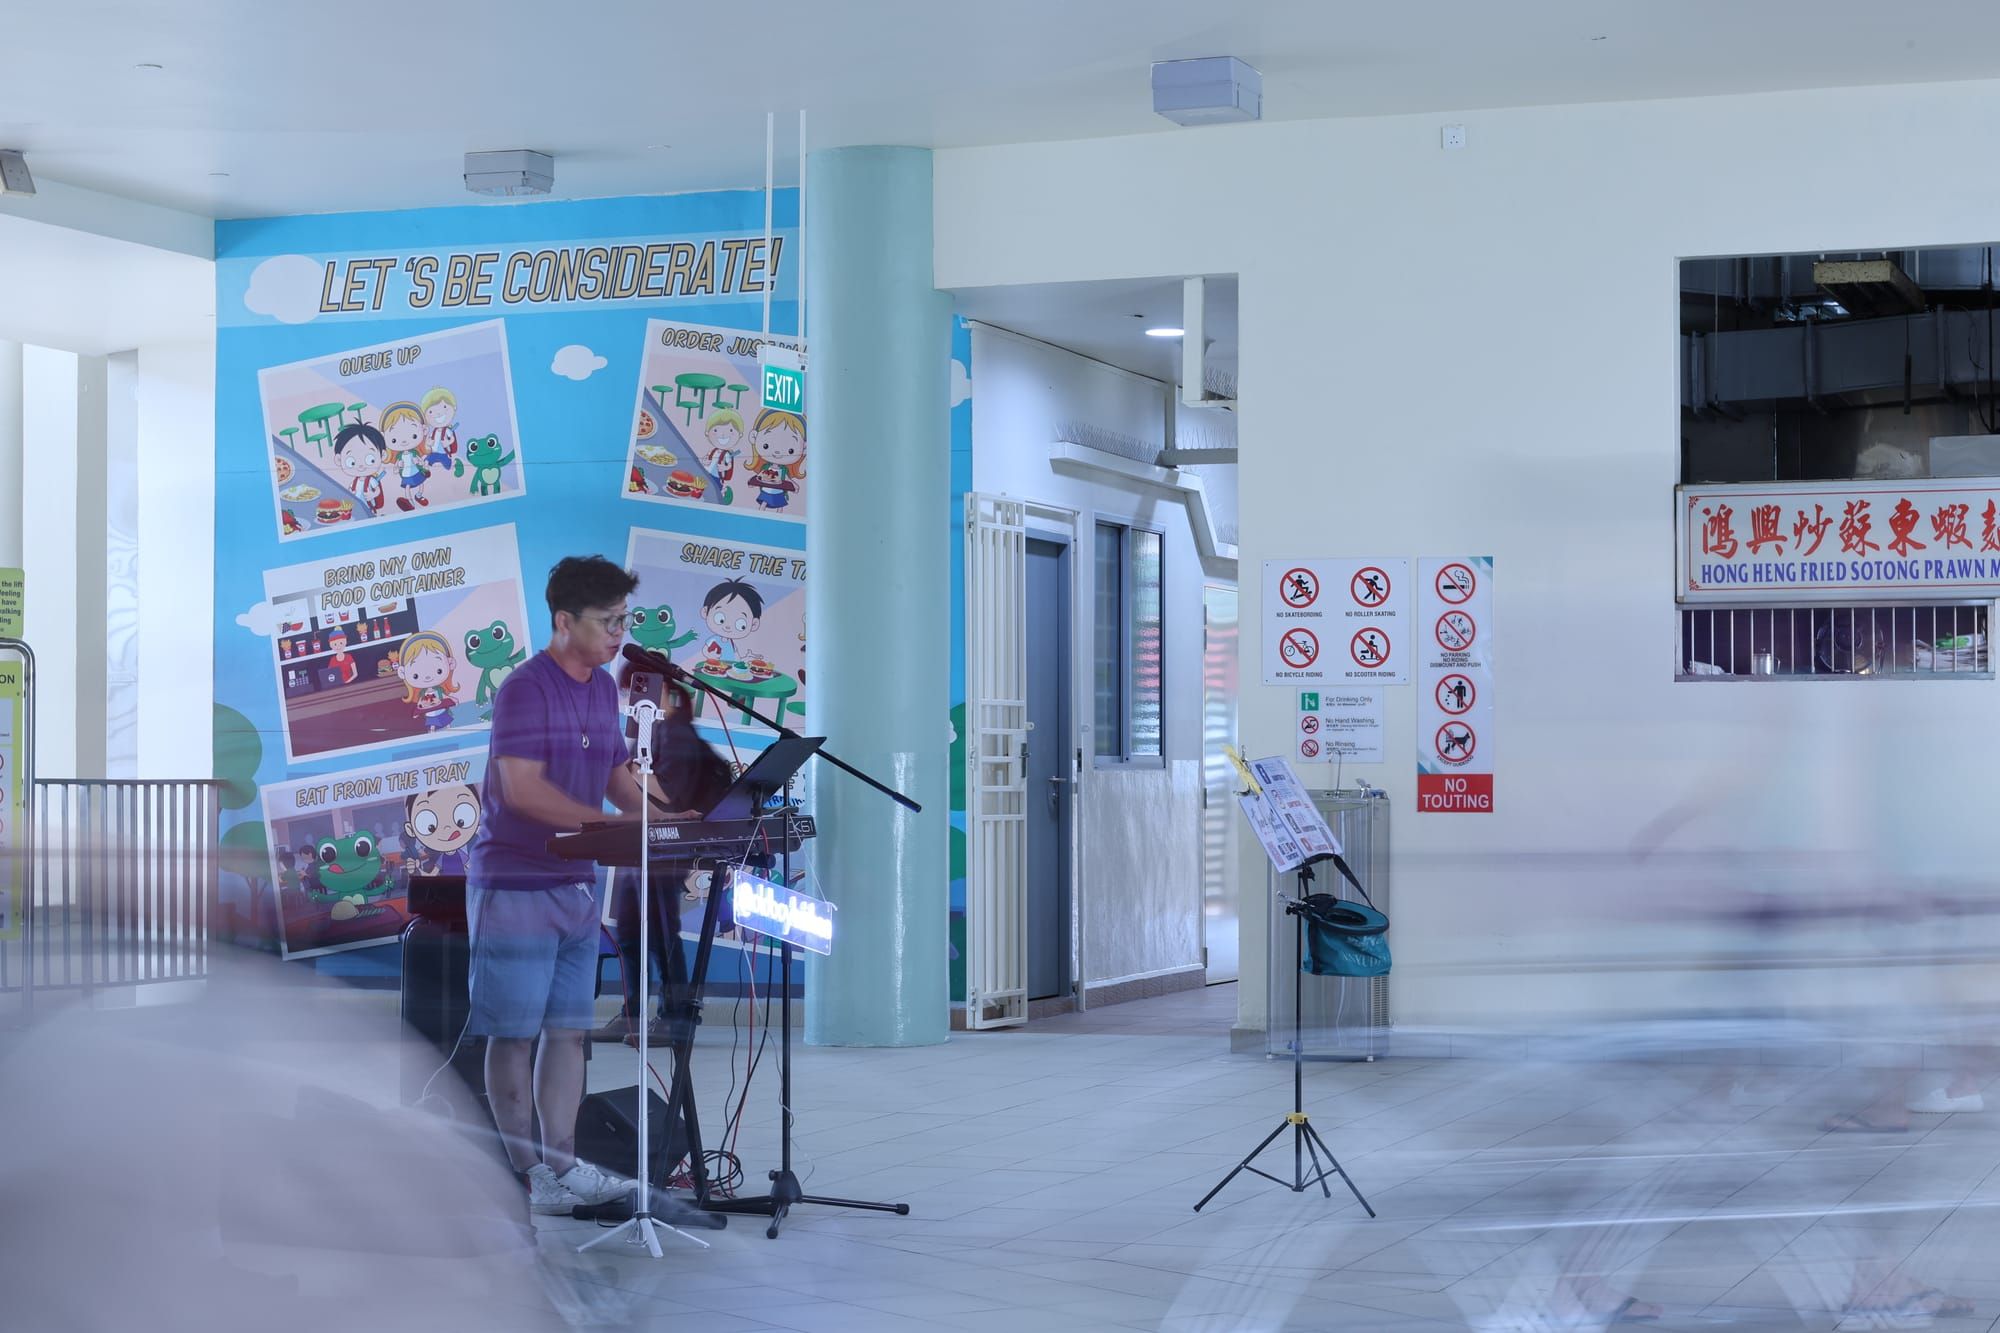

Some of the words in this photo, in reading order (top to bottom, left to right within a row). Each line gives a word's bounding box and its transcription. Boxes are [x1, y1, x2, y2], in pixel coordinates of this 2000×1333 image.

[319, 257, 398, 312] LET
[441, 252, 500, 307] BE
[502, 237, 783, 304] CONSIDERATE!
[661, 328, 723, 352] ORDER
[727, 336, 776, 358] JUS
[339, 350, 392, 376] QUEUE
[397, 345, 421, 365] UP
[766, 371, 793, 405] EXIT
[324, 561, 375, 587] BRING
[380, 555, 406, 577] MY
[412, 547, 451, 570] OWN
[680, 542, 745, 570] SHARE
[749, 553, 787, 577] THE
[791, 559, 806, 581] T
[1702, 563, 1748, 583] HONG
[1753, 562, 1796, 582] HENG
[1801, 561, 1847, 581] FRIED
[1851, 559, 1919, 580] SOTONG
[1924, 558, 1985, 579] PRAWN
[322, 586, 365, 610] FOOD
[371, 567, 465, 601] CONTAINER
[1360, 696, 1373, 704] Only
[296, 785, 328, 808] EAT
[333, 777, 382, 801] FROM
[386, 770, 418, 792] THE
[424, 761, 470, 786] TRAY
[1445, 778, 1467, 792] NO
[1422, 794, 1489, 808] TOUTING
[655, 826, 680, 840] YAMAHA
